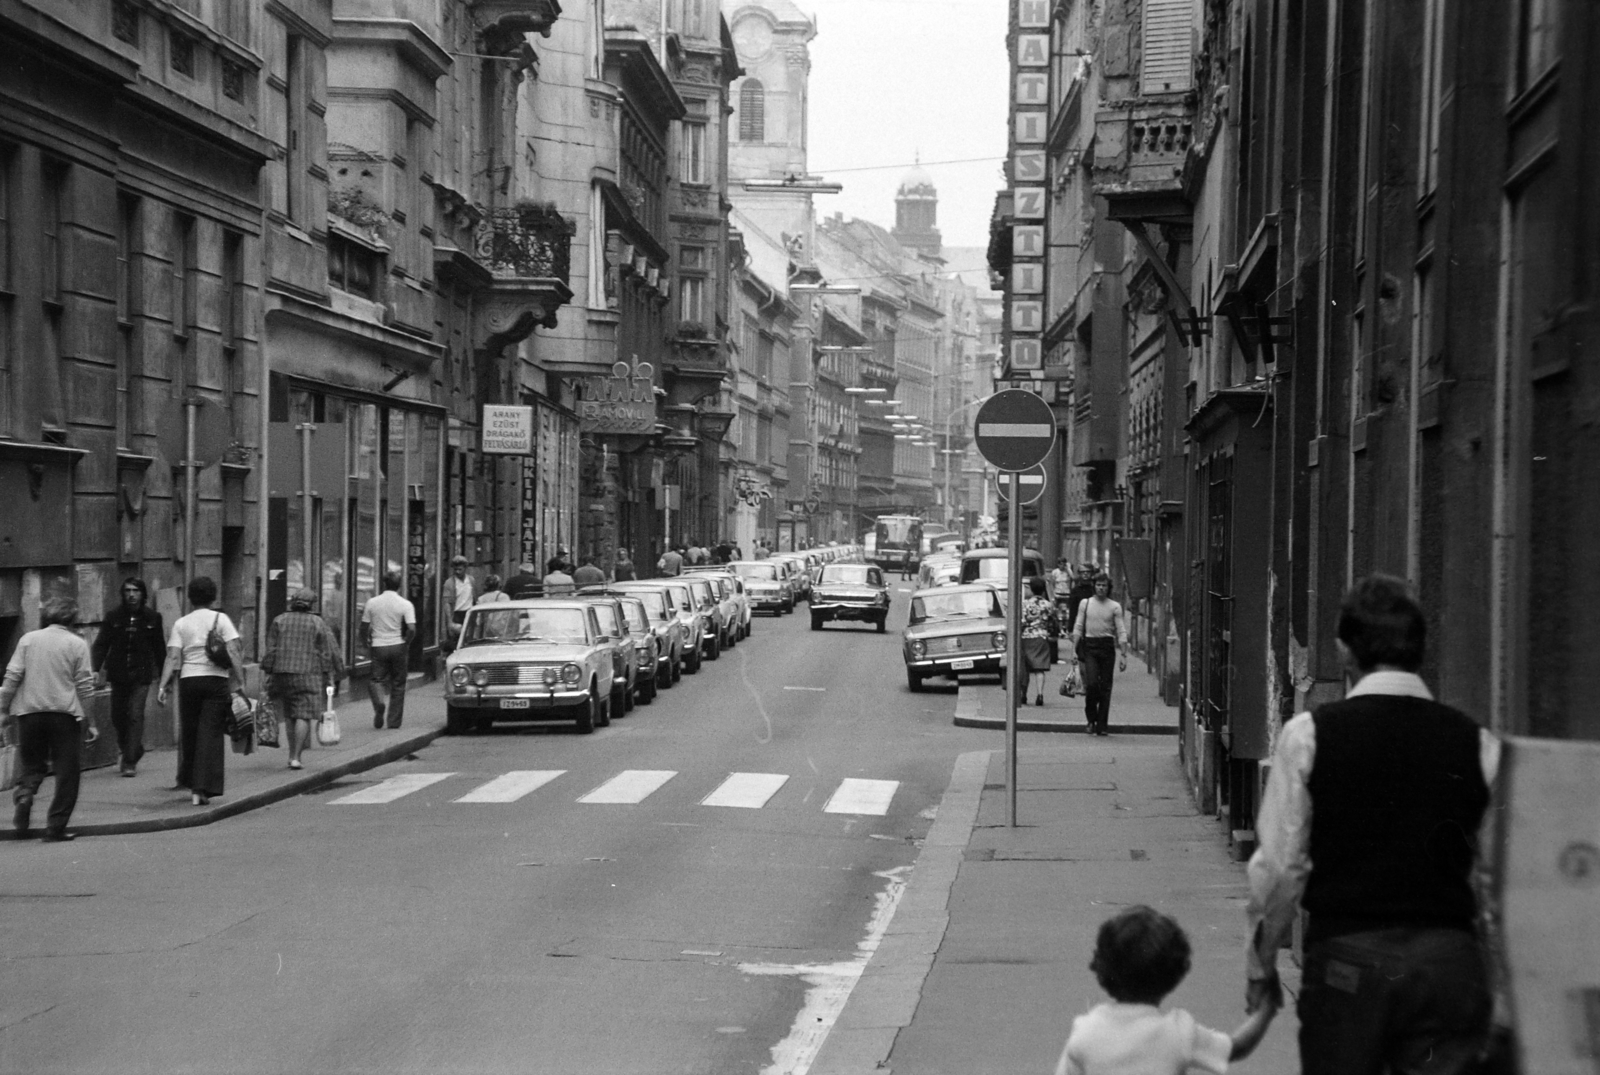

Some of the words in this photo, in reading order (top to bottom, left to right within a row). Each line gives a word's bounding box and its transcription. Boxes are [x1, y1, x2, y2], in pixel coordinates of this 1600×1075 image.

[492, 411, 521, 419] ARANY
[492, 419, 519, 428] EZÜST
[523, 456, 535, 510] RKLIN
[523, 517, 534, 563] JÁTÉ
